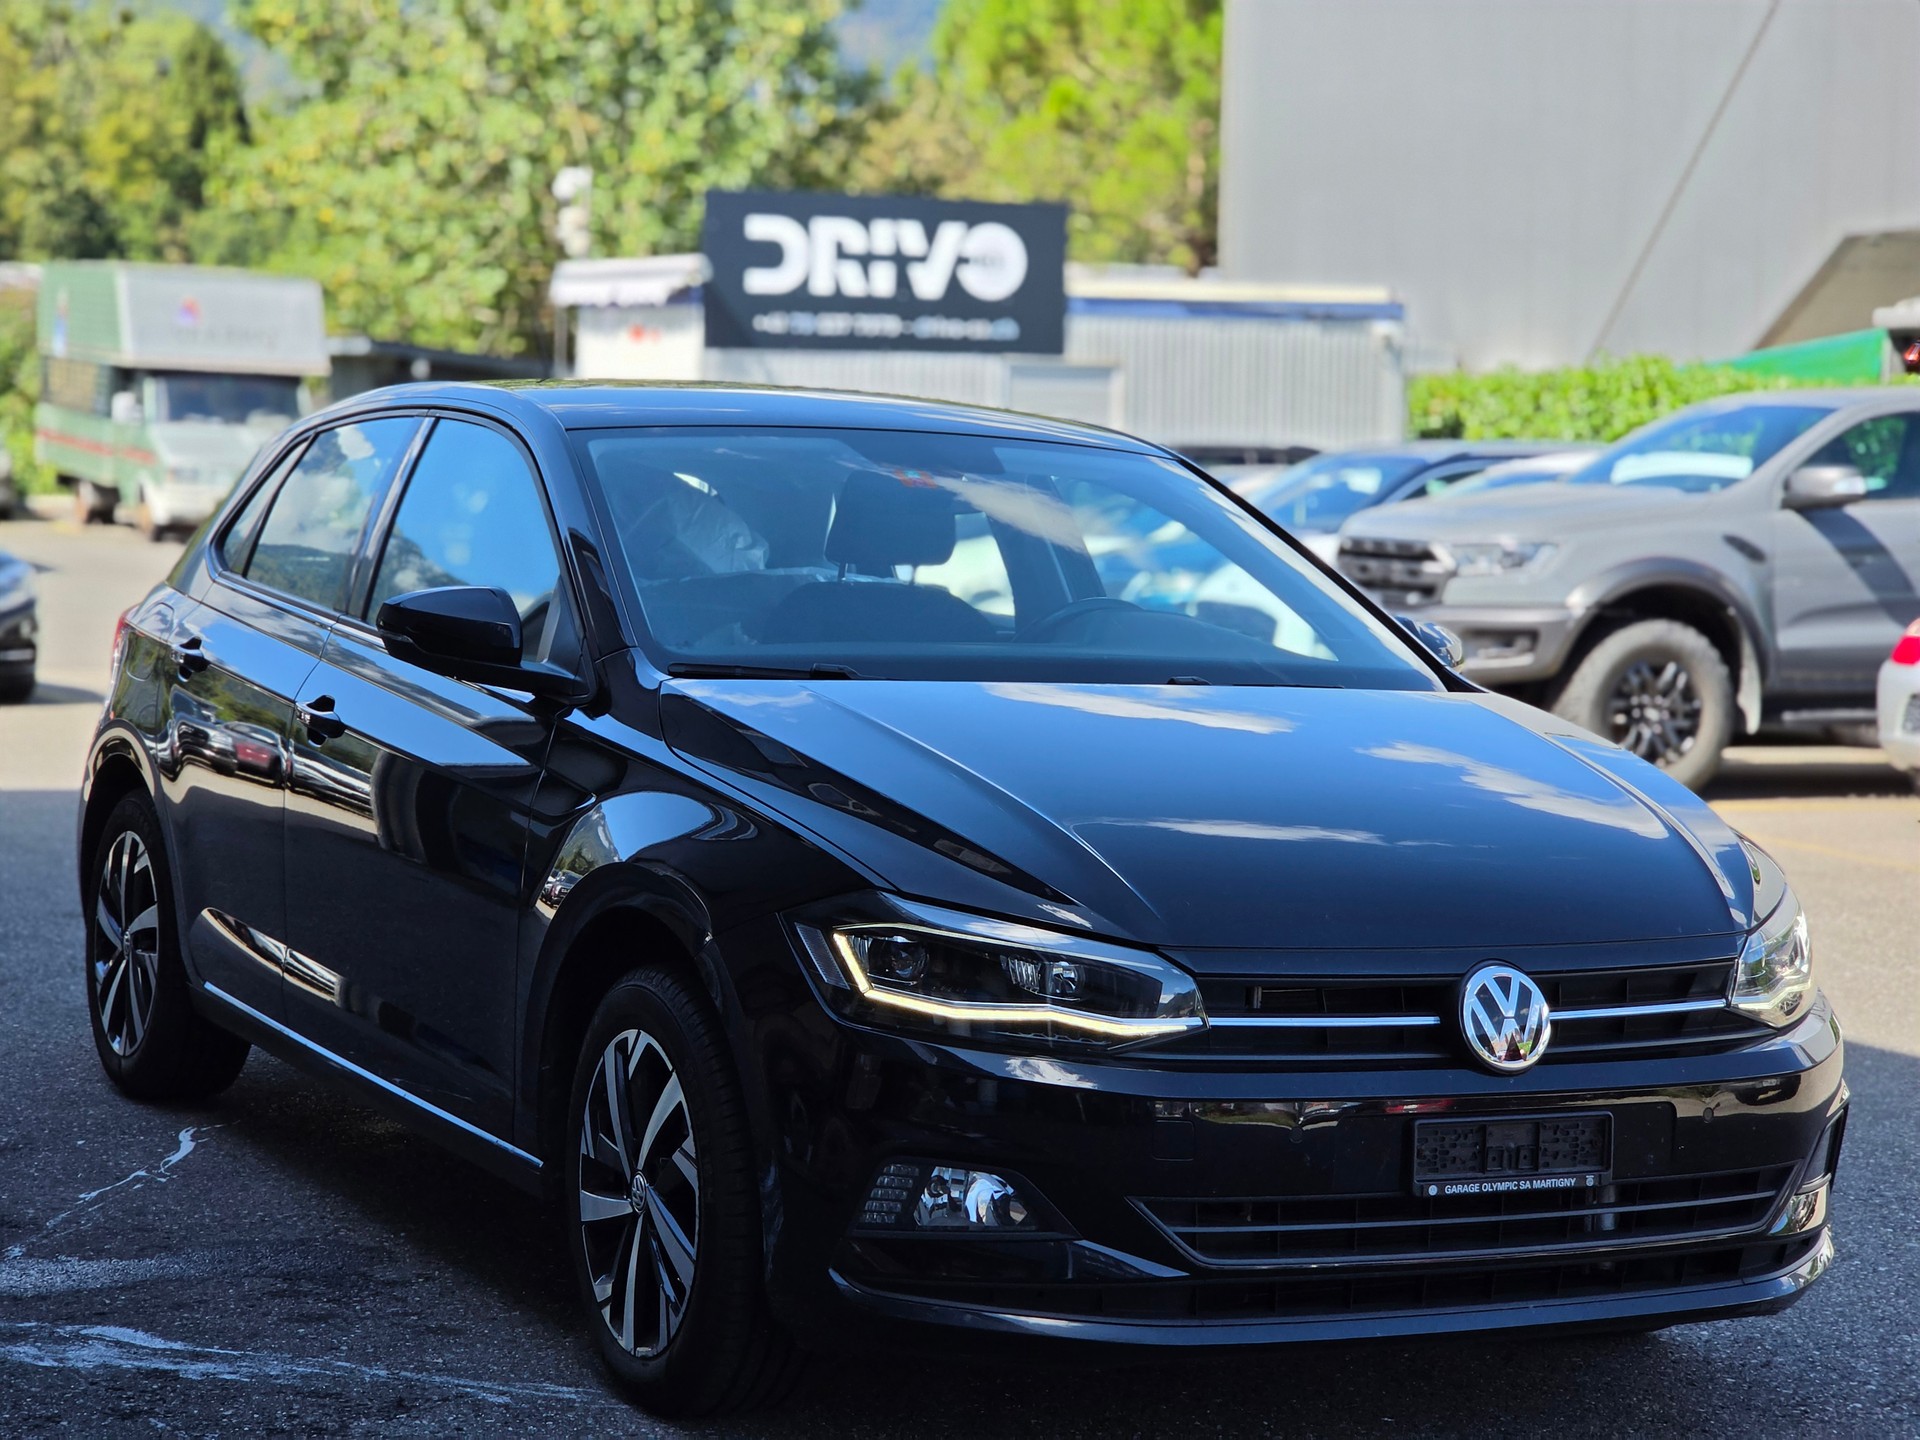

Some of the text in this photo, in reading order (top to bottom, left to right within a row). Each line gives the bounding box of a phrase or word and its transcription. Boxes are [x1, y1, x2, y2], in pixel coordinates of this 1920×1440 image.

[1444, 1178, 1577, 1194] GARAGE OLYMPIC SA MARTIGNY
